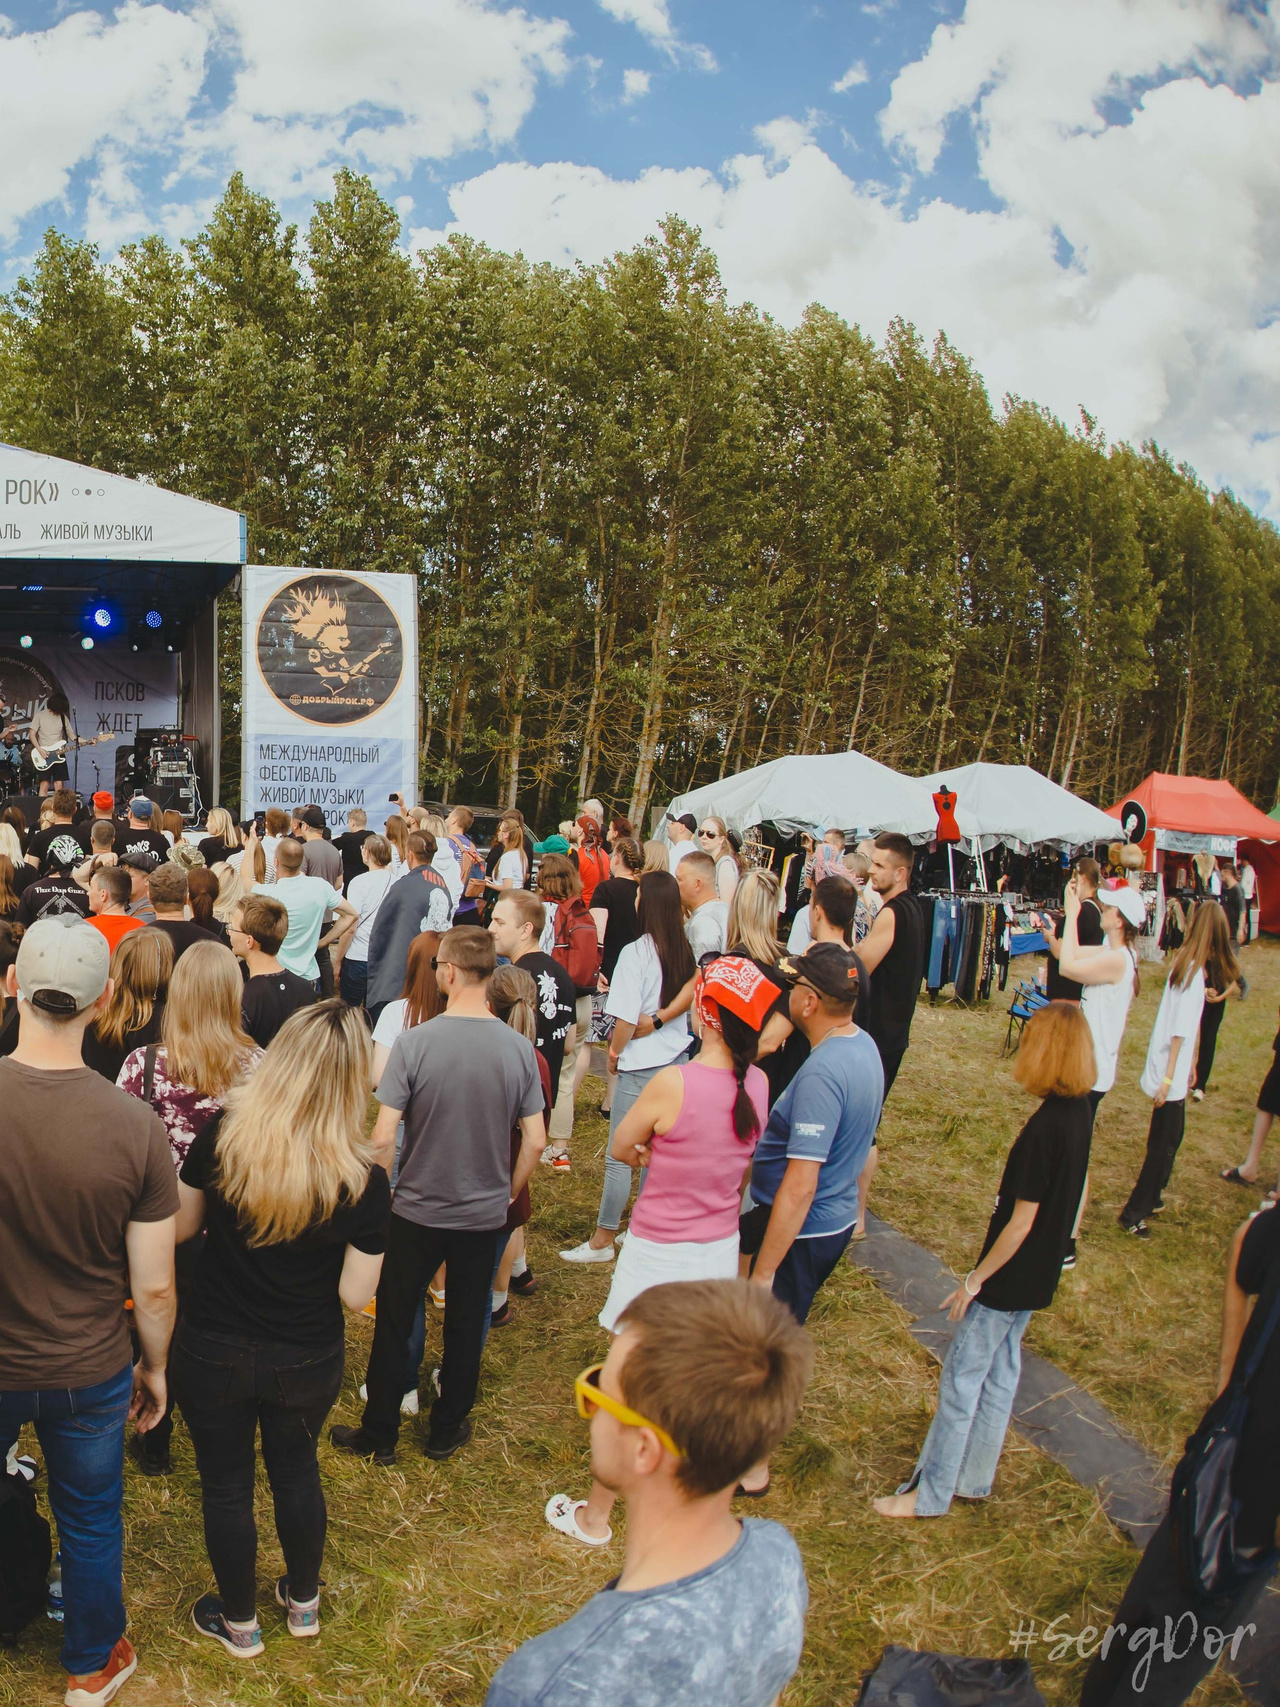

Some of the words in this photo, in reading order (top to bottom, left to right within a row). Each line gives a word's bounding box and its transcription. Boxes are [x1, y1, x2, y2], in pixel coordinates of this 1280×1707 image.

[5, 479, 59, 505] РОК»
[40, 520, 89, 540] ЖИВОЙ
[93, 523, 153, 542] МУЗЫКИ
[95, 681, 145, 702] ПСКОВ
[302, 695, 375, 707] ДОБРЫЙРОК.РФ
[96, 712, 144, 733] ЖДЕТ
[259, 743, 380, 764] МЕЖДУНАРОДНЫЙ
[259, 765, 337, 783] ФЕСТИВАЛЬ
[259, 785, 306, 804] ЖИВОЙ
[310, 788, 365, 805] МУЗЫКИ
[324, 810, 349, 826] РОК
